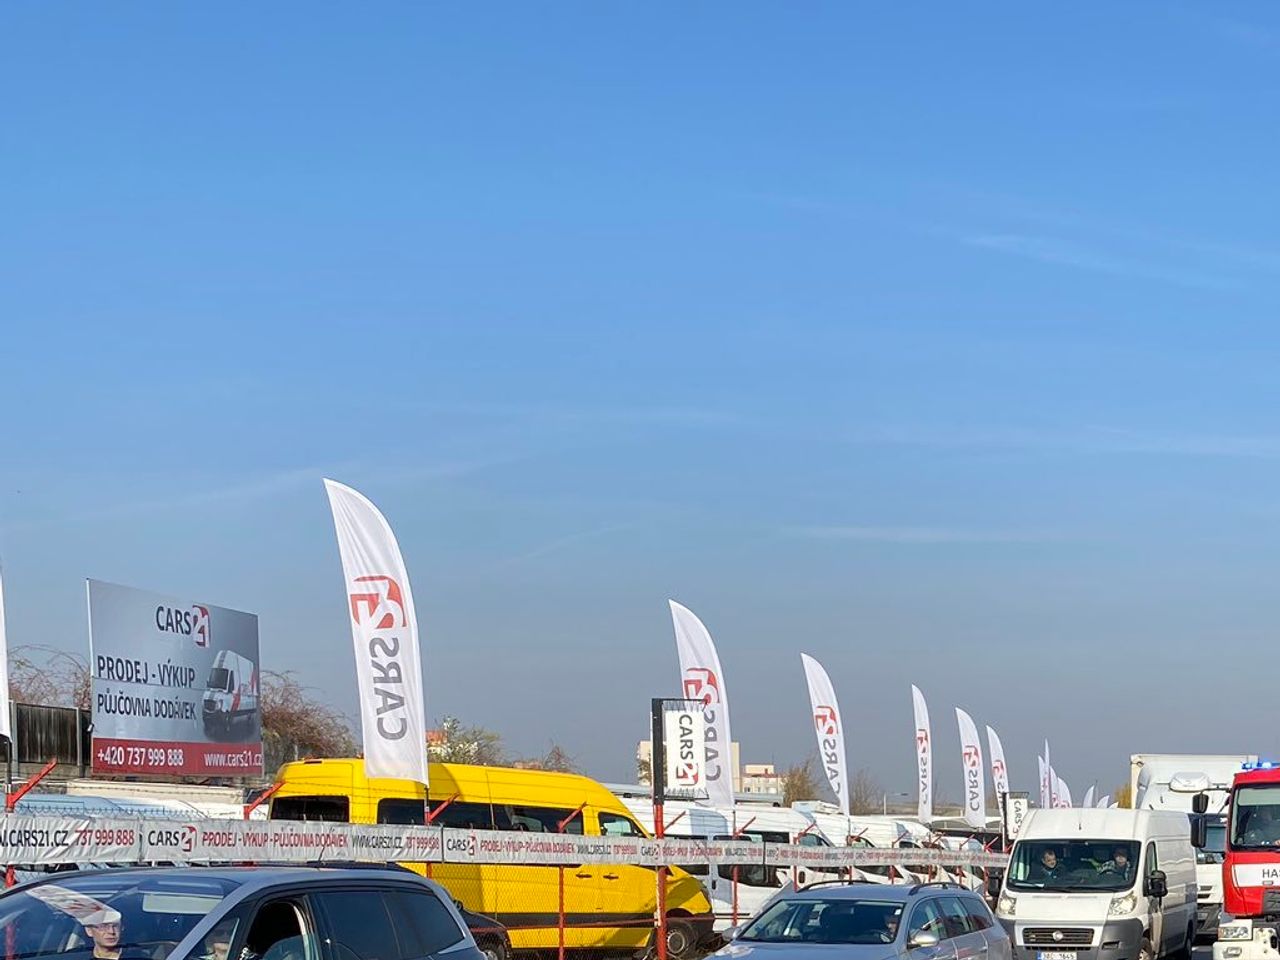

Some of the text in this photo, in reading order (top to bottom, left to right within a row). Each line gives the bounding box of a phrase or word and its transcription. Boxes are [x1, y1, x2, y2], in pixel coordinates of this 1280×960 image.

[156, 604, 211, 648] CARS21
[97, 655, 148, 684] PRODEJ
[158, 658, 195, 688] VÝKUP
[97, 688, 197, 720] PŮJČOVNA DODÁVEK
[97, 747, 184, 767] +420 737 999 888
[204, 751, 263, 767] www.cars21.cz
[676, 714, 698, 786] CARS21
[75, 830, 92, 847] 737
[94, 829, 114, 846] 999
[115, 829, 135, 845] 888
[202, 831, 237, 847] PRODEJ
[242, 829, 269, 848] VÝKUP
